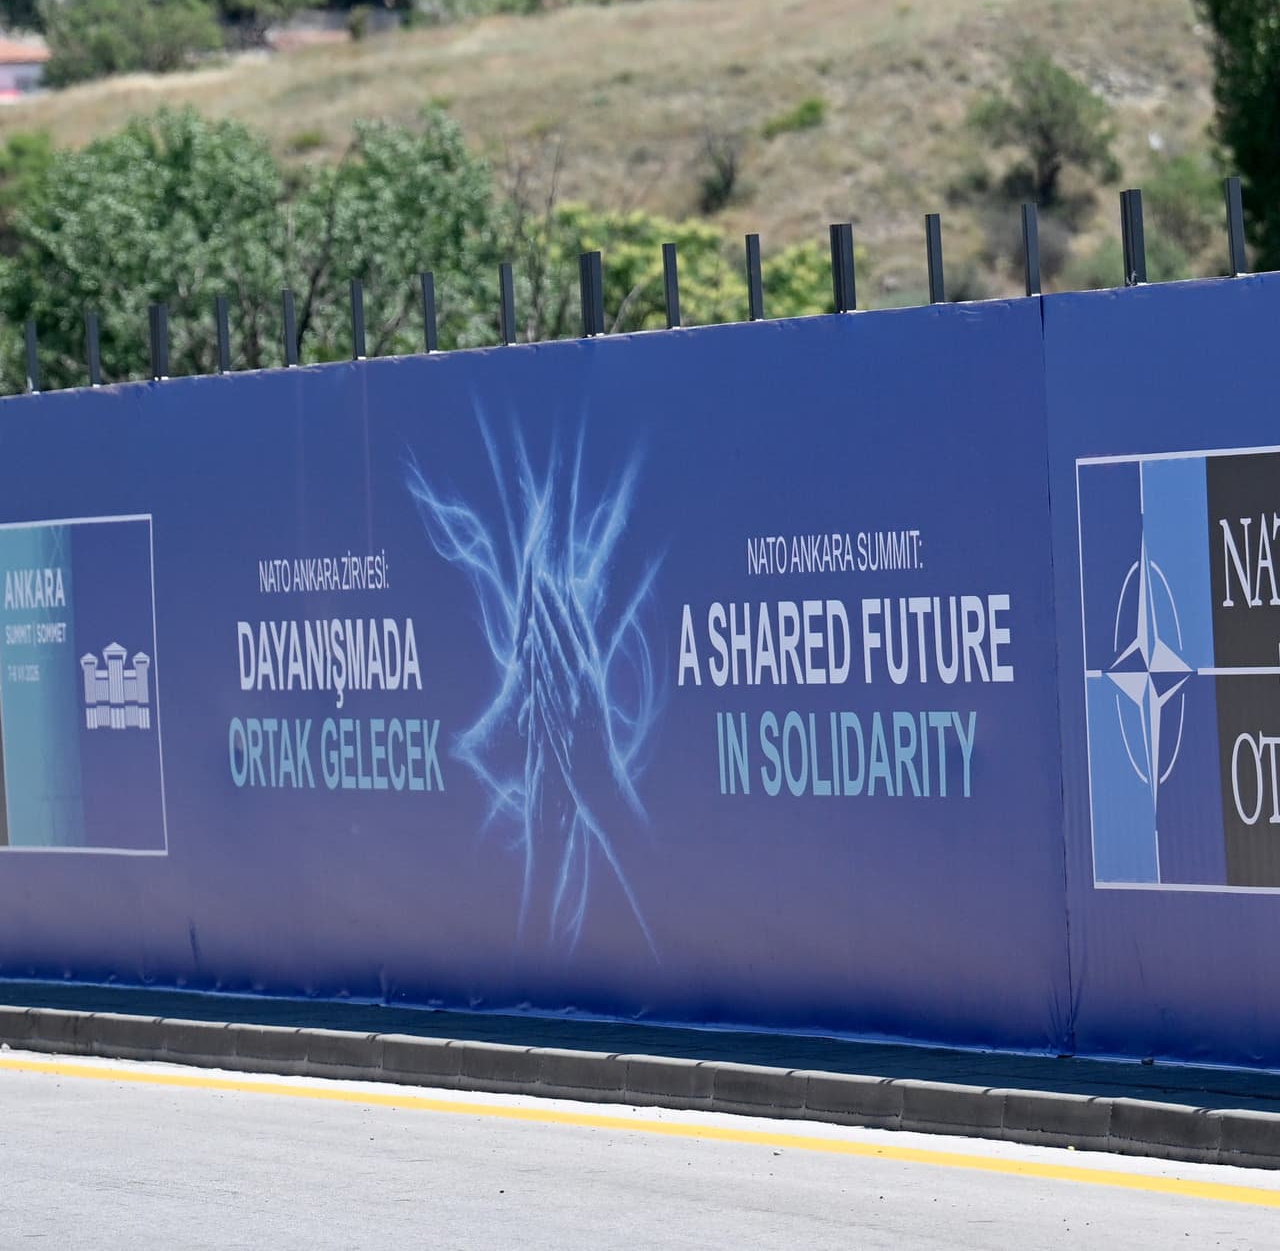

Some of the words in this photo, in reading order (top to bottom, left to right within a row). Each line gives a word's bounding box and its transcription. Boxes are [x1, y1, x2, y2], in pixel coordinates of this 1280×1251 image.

[4, 568, 66, 610] ANKARA
[259, 559, 291, 592] NATO
[293, 557, 341, 591] ANKARA
[342, 549, 389, 590] ZİRVESİ:
[747, 537, 788, 575] NATO
[790, 533, 856, 573] ANKARA
[857, 530, 923, 570] SUMMIT:
[237, 618, 422, 708] DAYANIŞMADA
[678, 604, 702, 686] A
[708, 599, 851, 686] SHARED
[862, 594, 1014, 684] FUTURE
[228, 716, 316, 789] ORTAK
[321, 718, 445, 792] GELECEK
[717, 713, 750, 794] IN
[759, 710, 977, 797] SOLIDARITY
